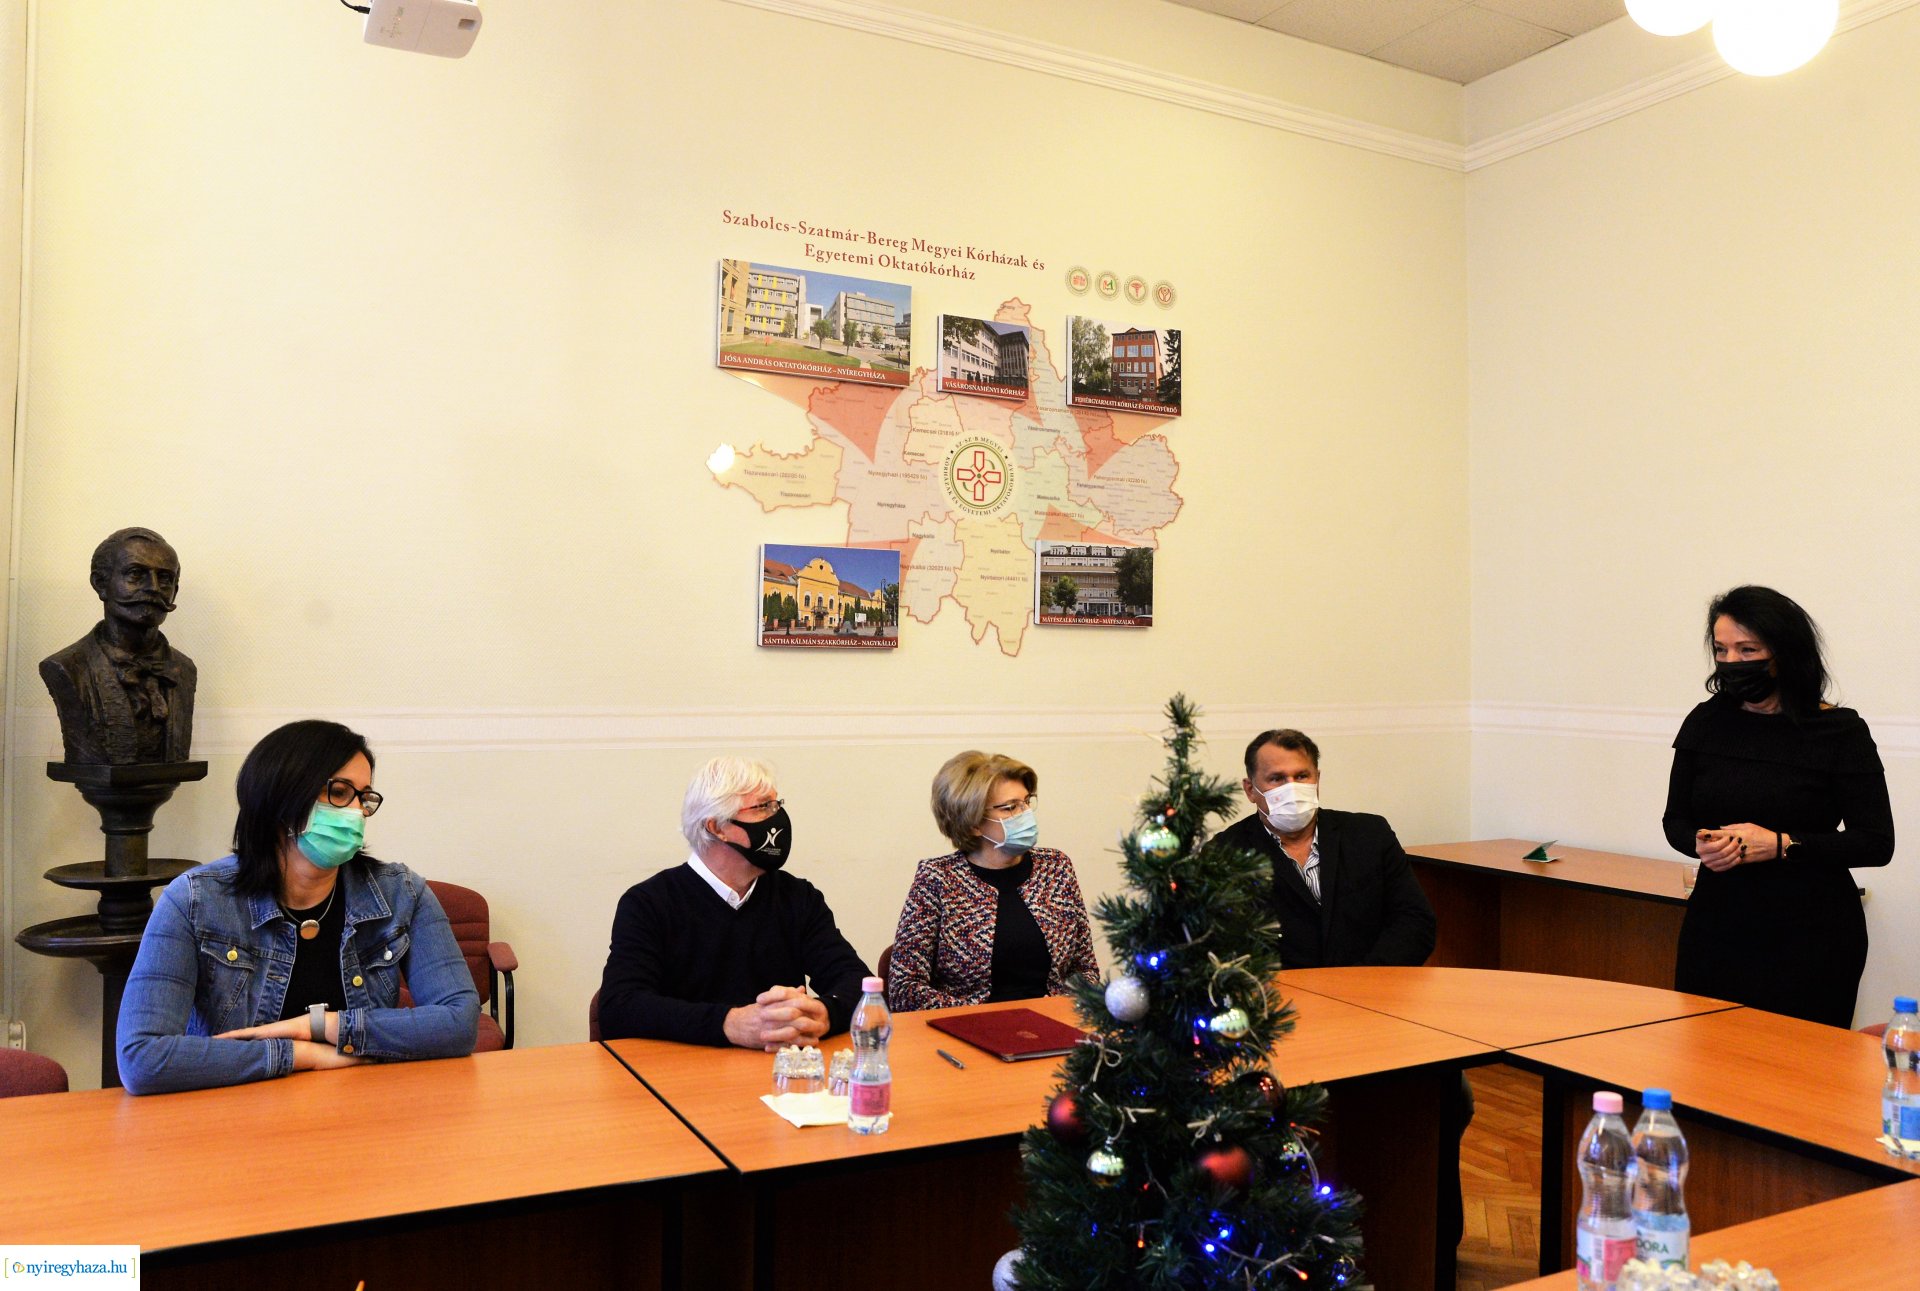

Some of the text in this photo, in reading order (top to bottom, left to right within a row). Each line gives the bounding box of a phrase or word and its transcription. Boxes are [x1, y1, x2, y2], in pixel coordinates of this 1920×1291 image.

[722, 209, 1045, 271] Szabolcs-Szatmár-Bereg Megyei Kórházak és
[805, 243, 976, 280] Egyetemi Oktatókórház
[723, 354, 741, 364] JÓSA
[742, 356, 773, 367] ANDRÁS
[773, 360, 832, 374] OKTATÓKÓRHÁZ
[837, 367, 886, 380] NYÍREGYHÁZA
[945, 381, 1025, 397] VÁSÁROSNAMÉNYI KÓRHÁZ
[1117, 400, 1137, 409] KÓRHÁZ
[1138, 402, 1145, 410] ÉS
[980, 437, 1004, 453] MEGYEI
[764, 637, 790, 645] SÁNTHA
[790, 637, 817, 645] KÁLMÁN
[817, 638, 858, 646] SZAKKÓRHÁZ
[861, 639, 897, 647] NAGYKÁLLÓ
